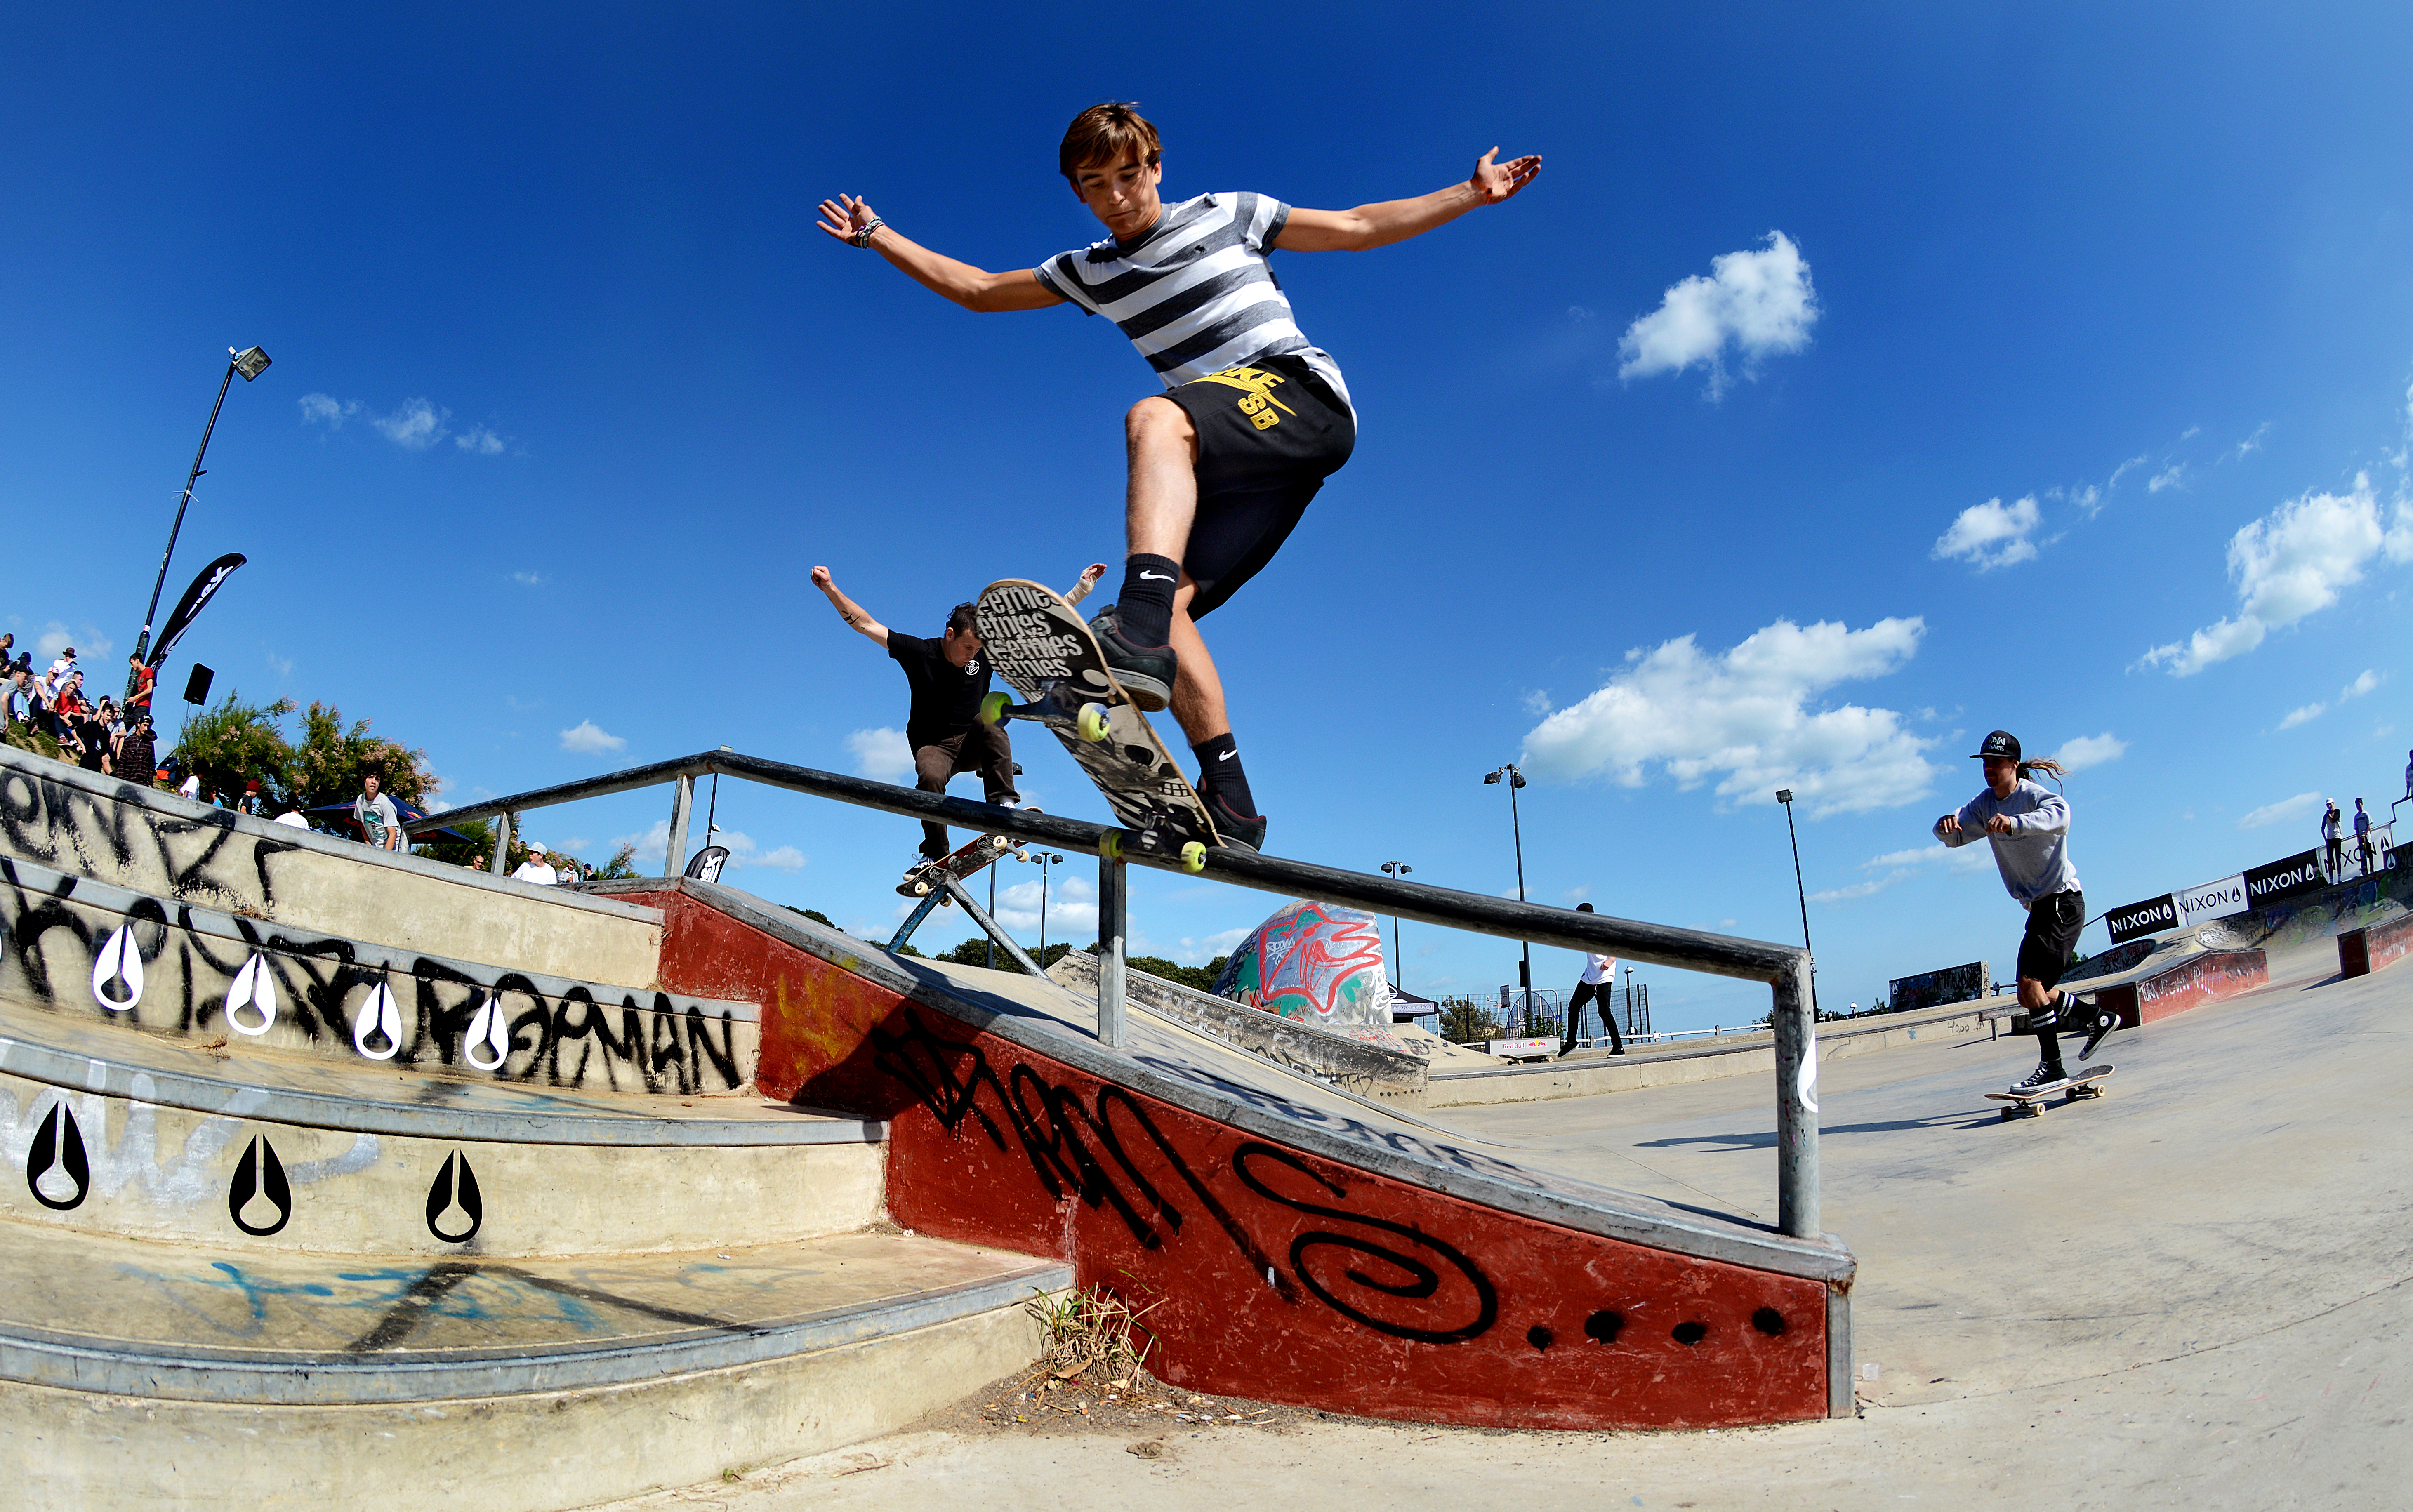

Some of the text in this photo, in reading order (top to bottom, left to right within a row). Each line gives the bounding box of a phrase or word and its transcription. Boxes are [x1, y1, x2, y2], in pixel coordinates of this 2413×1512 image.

[1238, 393, 1280, 430] SB
[2323, 841, 2377, 874] NXON
[2250, 868, 2302, 896] NIXON
[2179, 890, 2229, 914] NIXON
[2111, 907, 2161, 933] NIXON
